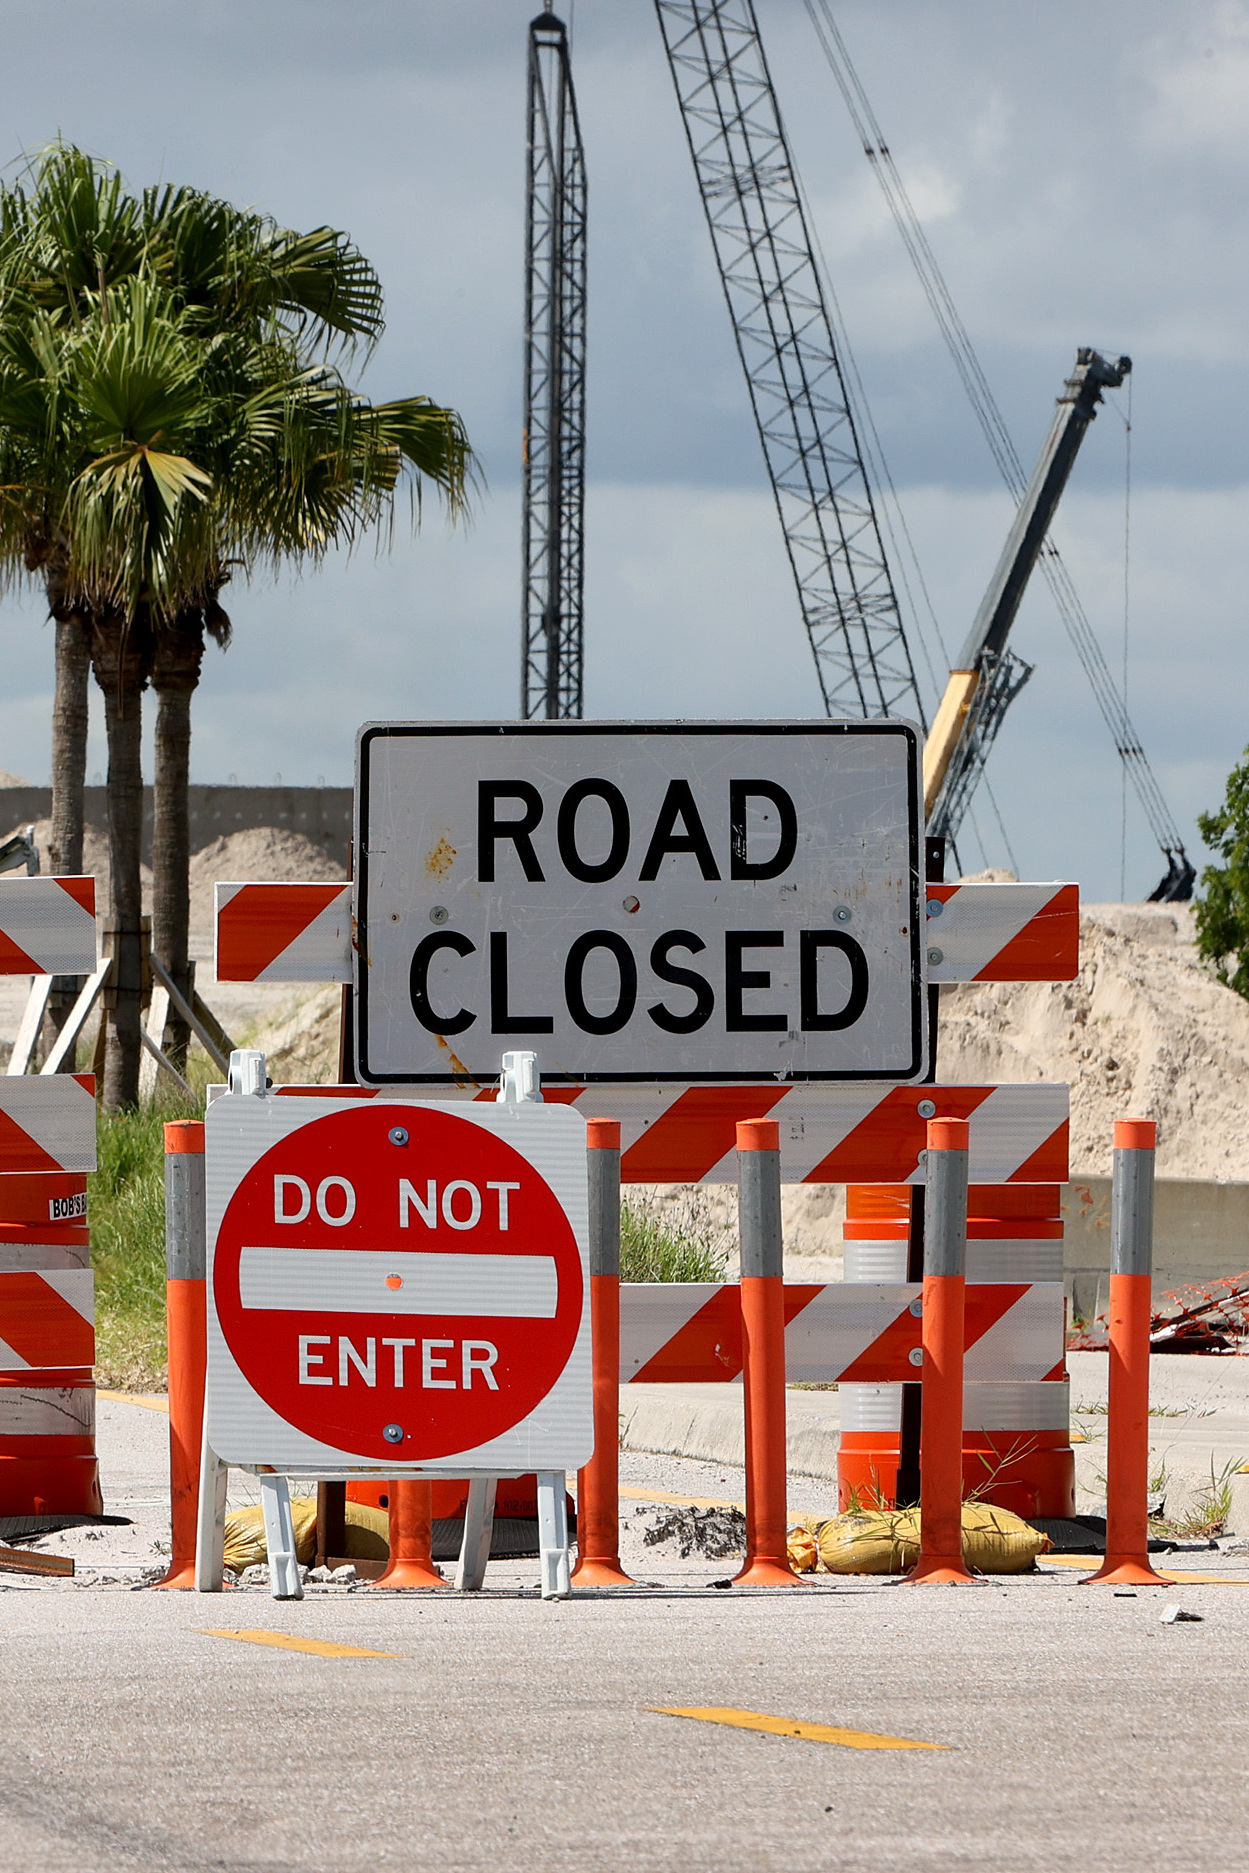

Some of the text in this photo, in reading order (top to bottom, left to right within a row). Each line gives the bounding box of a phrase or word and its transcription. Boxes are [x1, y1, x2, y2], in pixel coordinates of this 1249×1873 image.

[478, 778, 797, 883] ROAD
[410, 930, 868, 1036] CLOSED
[274, 1175, 520, 1230] DO NOT
[299, 1335, 499, 1390] ENTER
